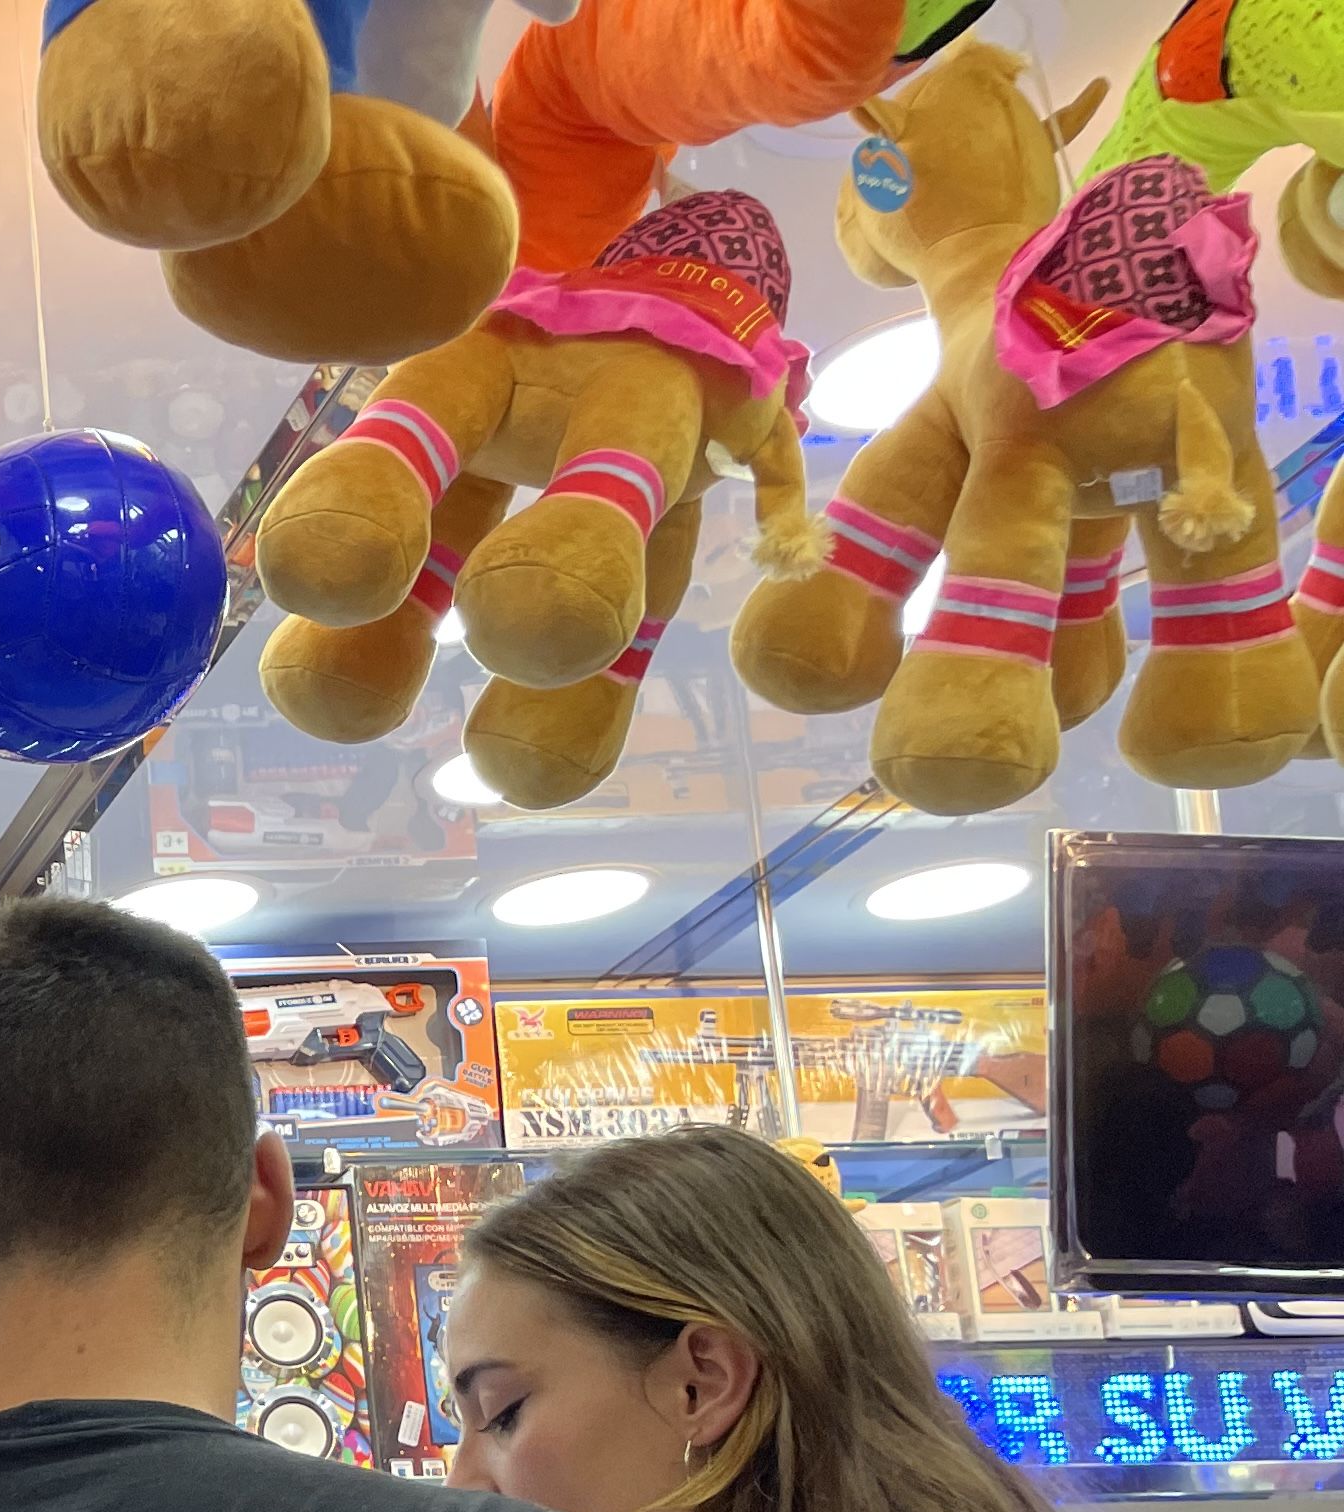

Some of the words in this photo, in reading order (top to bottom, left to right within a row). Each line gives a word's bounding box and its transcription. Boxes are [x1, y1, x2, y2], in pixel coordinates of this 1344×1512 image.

[366, 1203, 409, 1214] ALTAVOZ
[410, 1202, 469, 1214] MULTIMEDIA
[367, 1224, 423, 1233] COMPATIBLE
[424, 1224, 447, 1233] CON
